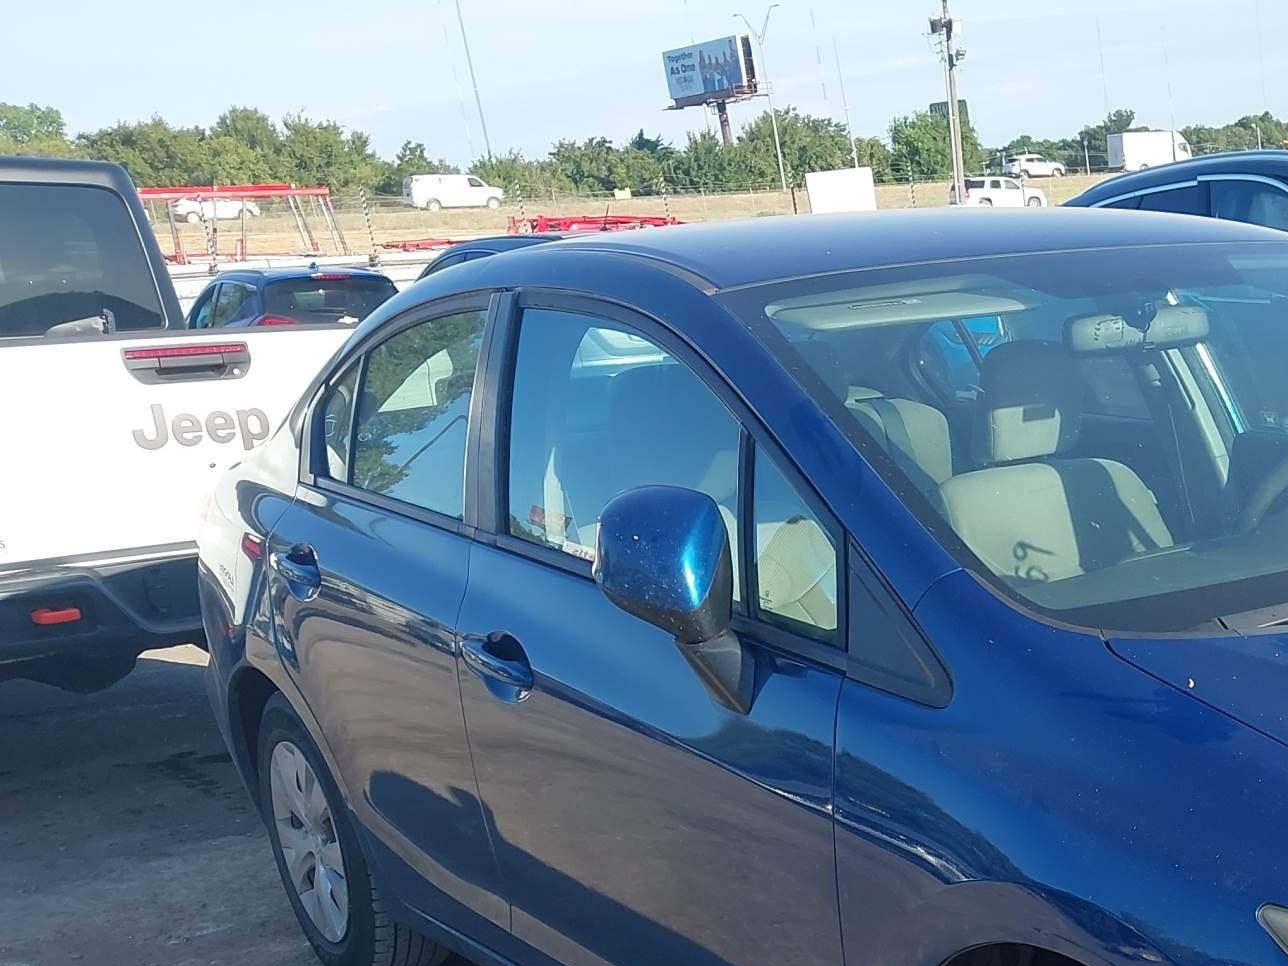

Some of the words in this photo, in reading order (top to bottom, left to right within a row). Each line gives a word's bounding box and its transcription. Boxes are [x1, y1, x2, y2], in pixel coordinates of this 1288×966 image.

[670, 66, 680, 76] As
[681, 63, 696, 73] One
[132, 404, 270, 450] Jeep
